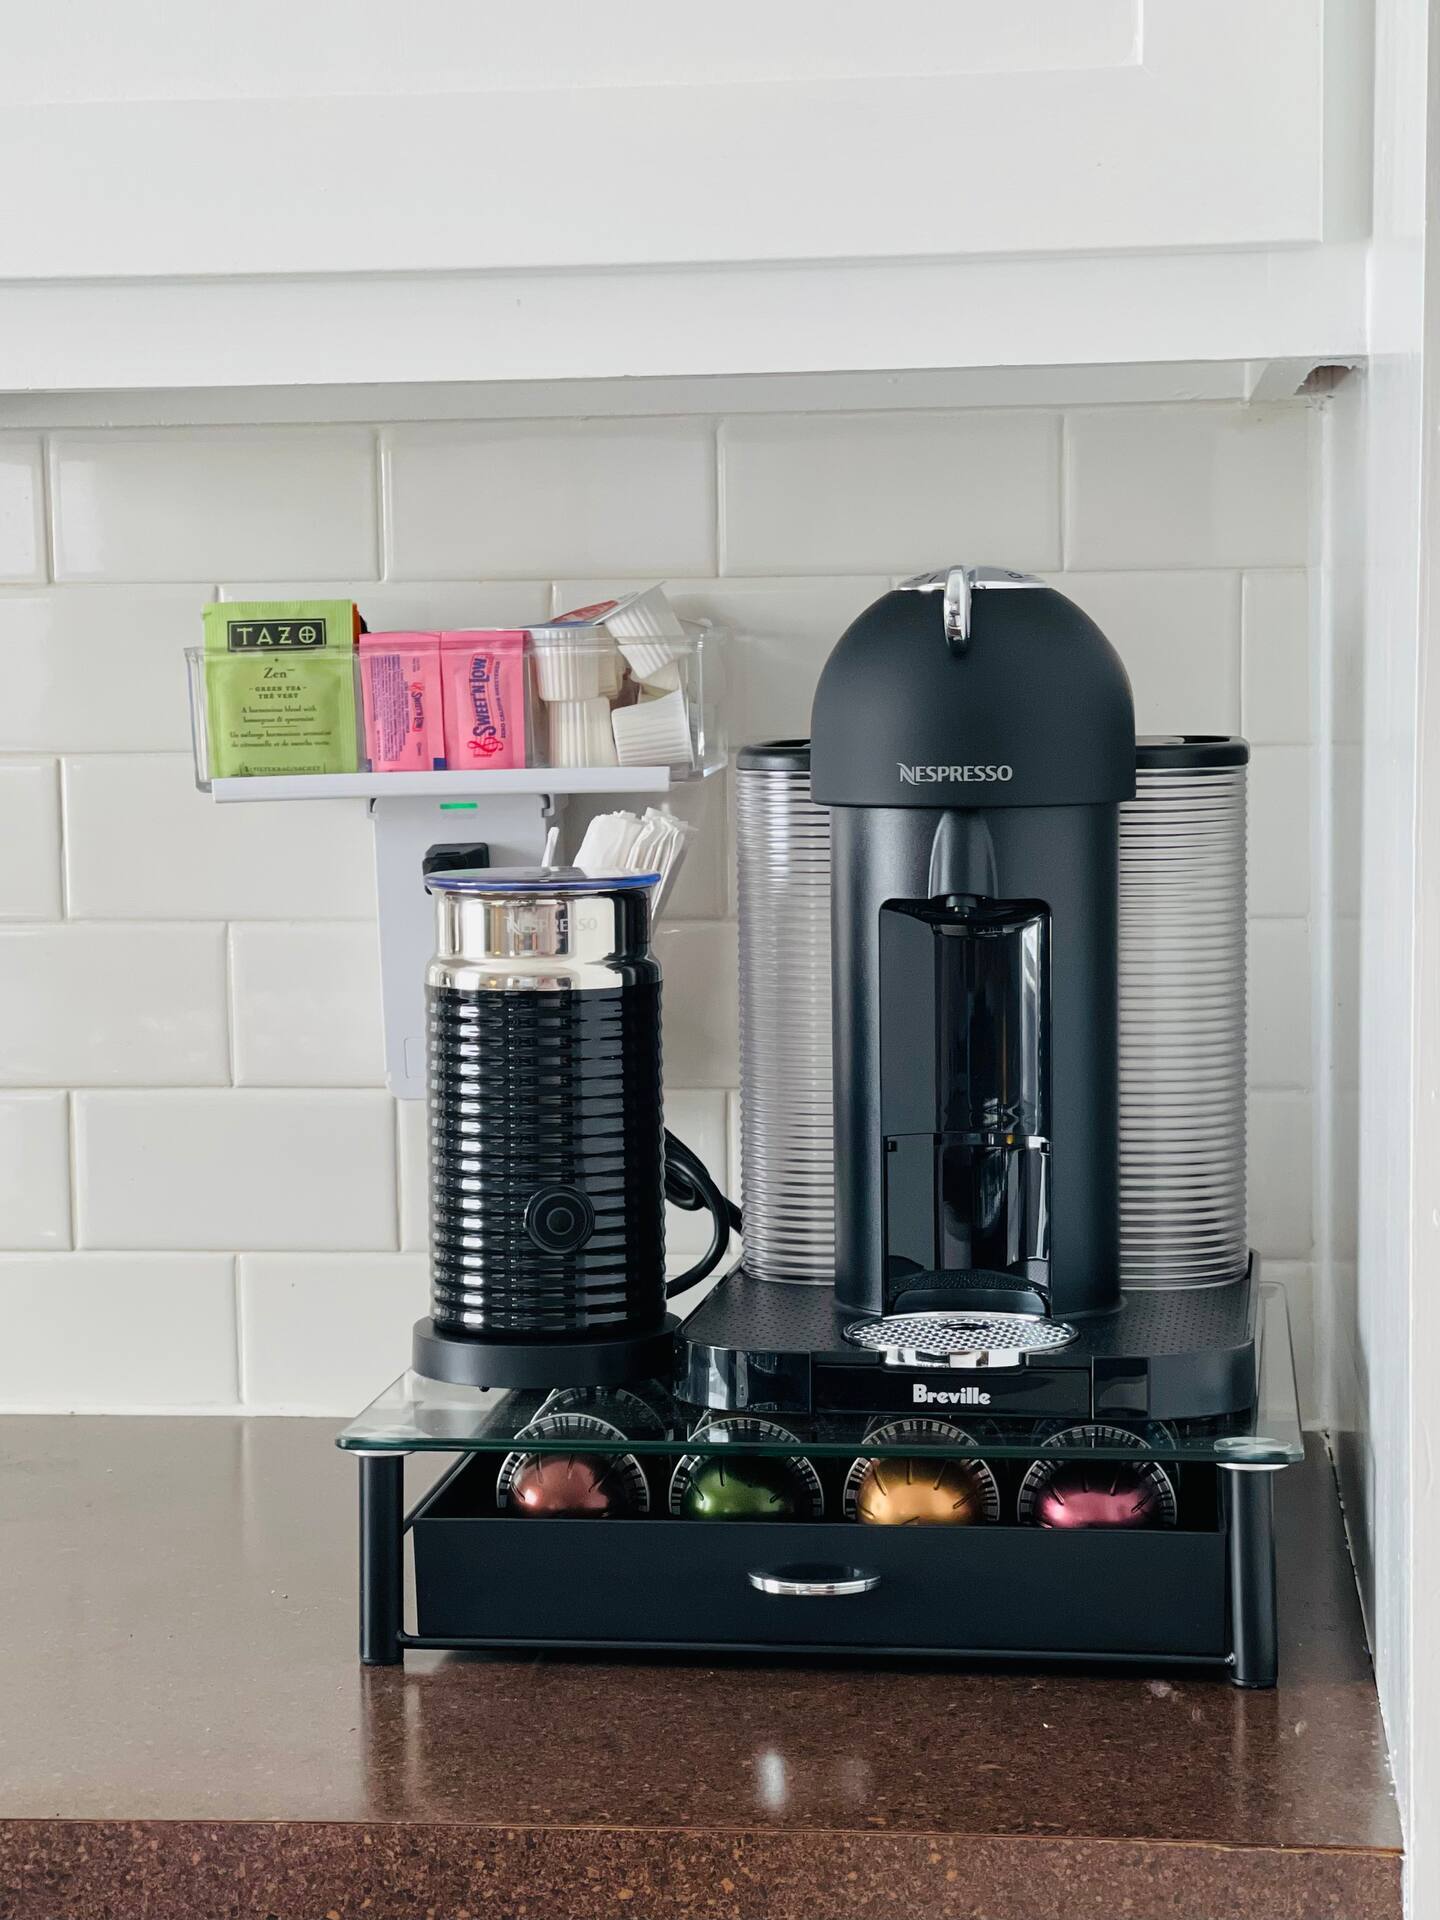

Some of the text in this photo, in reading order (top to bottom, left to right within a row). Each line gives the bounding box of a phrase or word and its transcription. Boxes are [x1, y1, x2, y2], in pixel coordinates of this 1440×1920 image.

[237, 626, 316, 645] TAZO
[896, 762, 1013, 786] NESPRESSO
[912, 1383, 991, 1405] Breville
